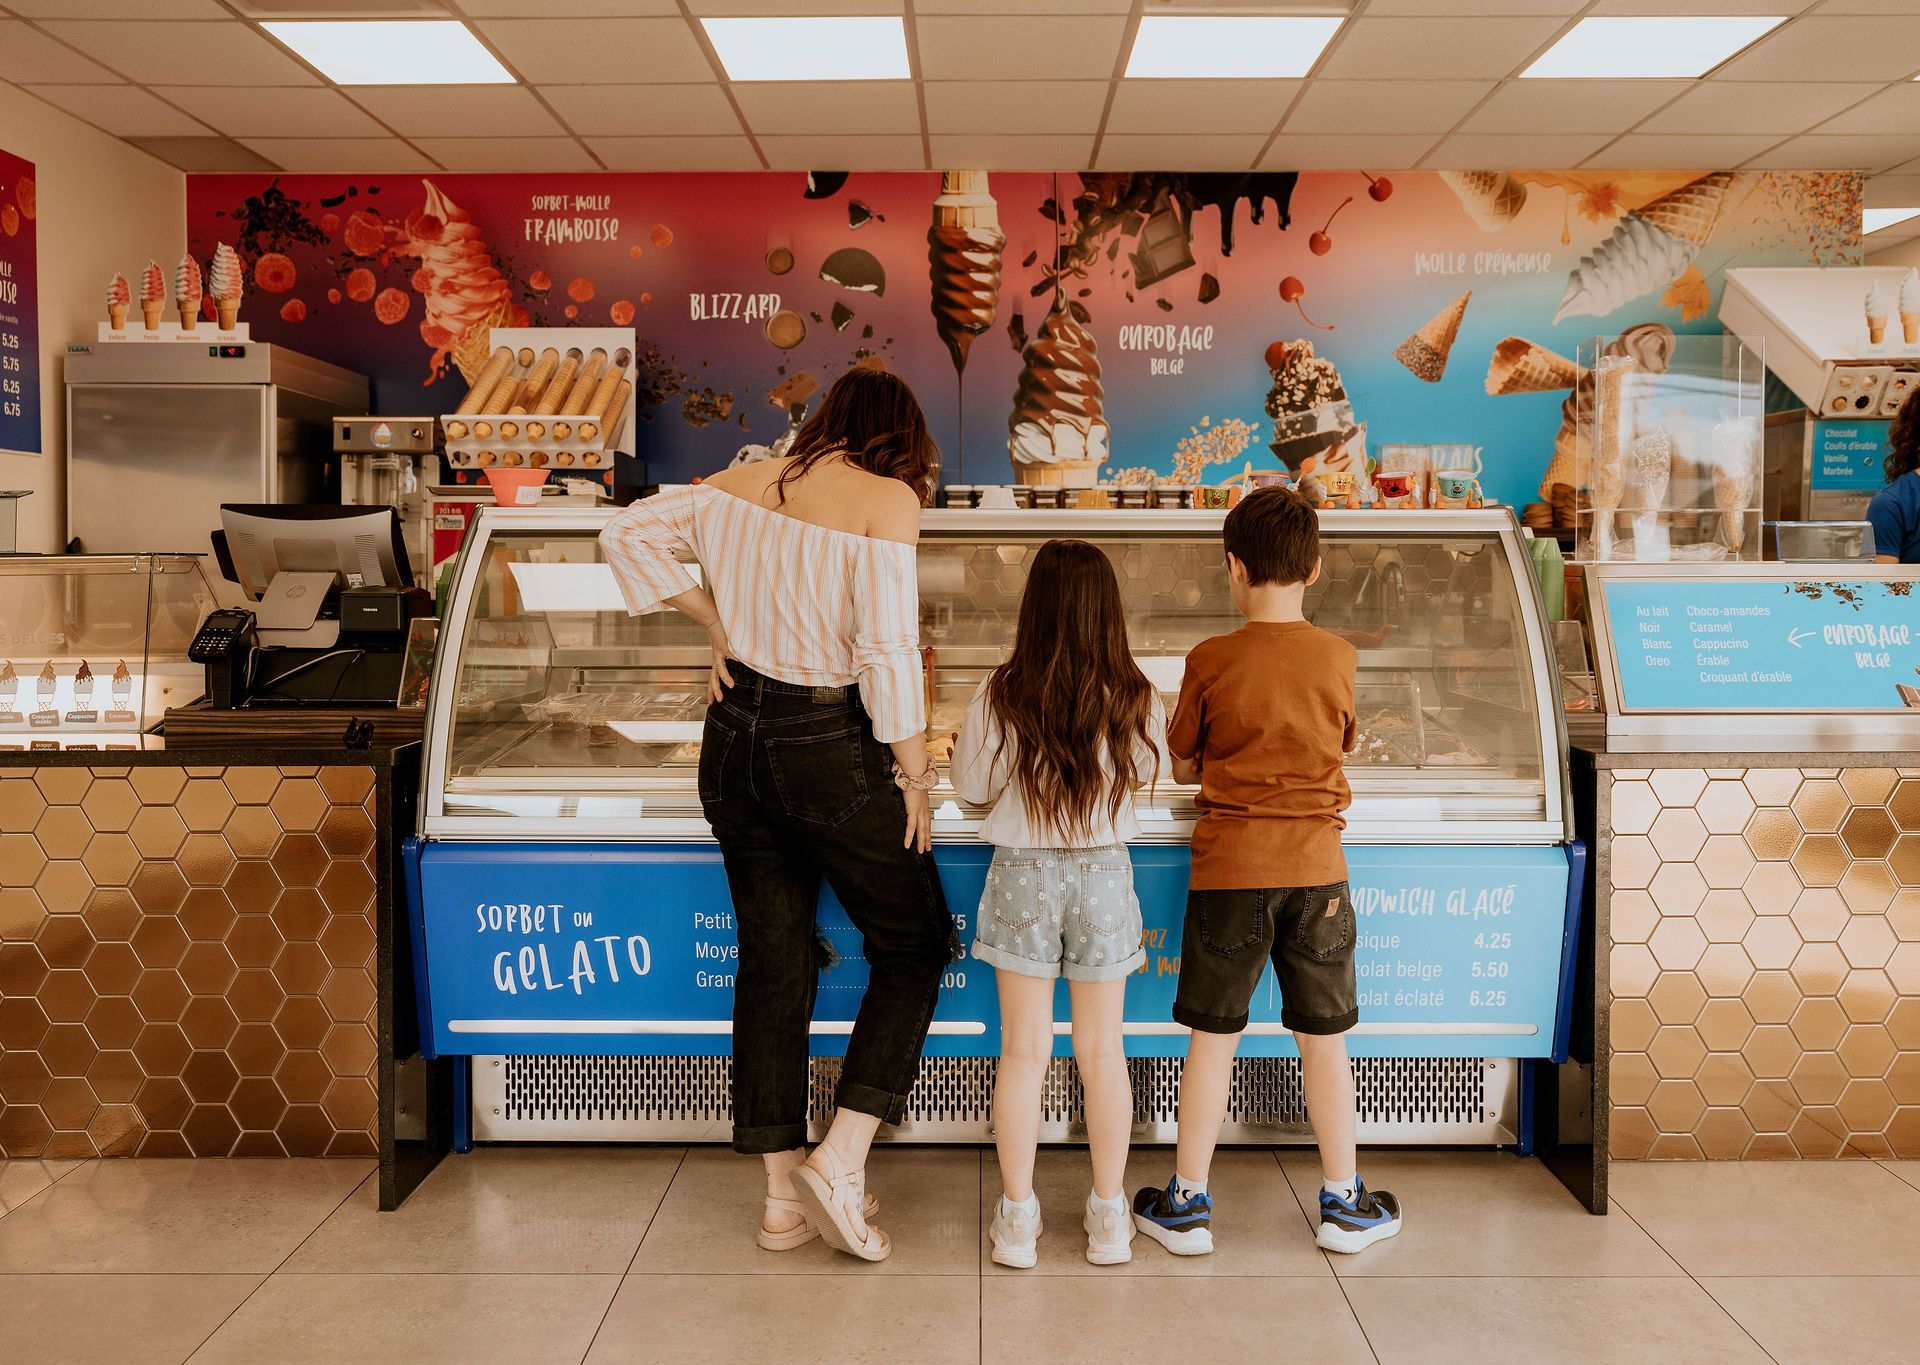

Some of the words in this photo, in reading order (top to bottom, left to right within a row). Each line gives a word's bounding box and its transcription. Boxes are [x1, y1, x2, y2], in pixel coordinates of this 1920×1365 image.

[688, 292, 782, 324] BLIZZARD
[2, 333, 19, 349] 5.25
[3, 355, 20, 372] 5.75
[3, 378, 20, 394] 6.25
[4, 401, 21, 417] 6.75
[1825, 428, 1858, 438] Chocolat
[1824, 441, 1847, 450] Coulis
[1823, 454, 1849, 463] Vanille
[1636, 606, 1650, 617] Au
[1652, 605, 1669, 617] lait
[1686, 605, 1771, 617] Choco-amandes
[1639, 622, 1661, 633] Noir
[1689, 622, 1733, 633] Caramel
[1642, 638, 1672, 649] Blanc
[1693, 638, 1749, 651] Cappucino
[1645, 655, 1670, 667] Oreo
[1697, 653, 1730, 666] Érable
[1700, 671, 1748, 685] Croquant
[1751, 671, 1792, 682] d'érable
[1350, 885, 1435, 918] NDWICH
[694, 911, 733, 929] Petit
[1356, 931, 1400, 952] sique
[1474, 932, 1511, 950] 4.25
[695, 942, 739, 963] Moye
[1396, 960, 1442, 980] belge
[1471, 961, 1509, 978] 5.50
[696, 970, 734, 988] Gran
[940, 972, 966, 988] .00
[1358, 989, 1389, 1006] olat
[1394, 989, 1445, 1007] éclaté
[1469, 990, 1507, 1007] 6.25
